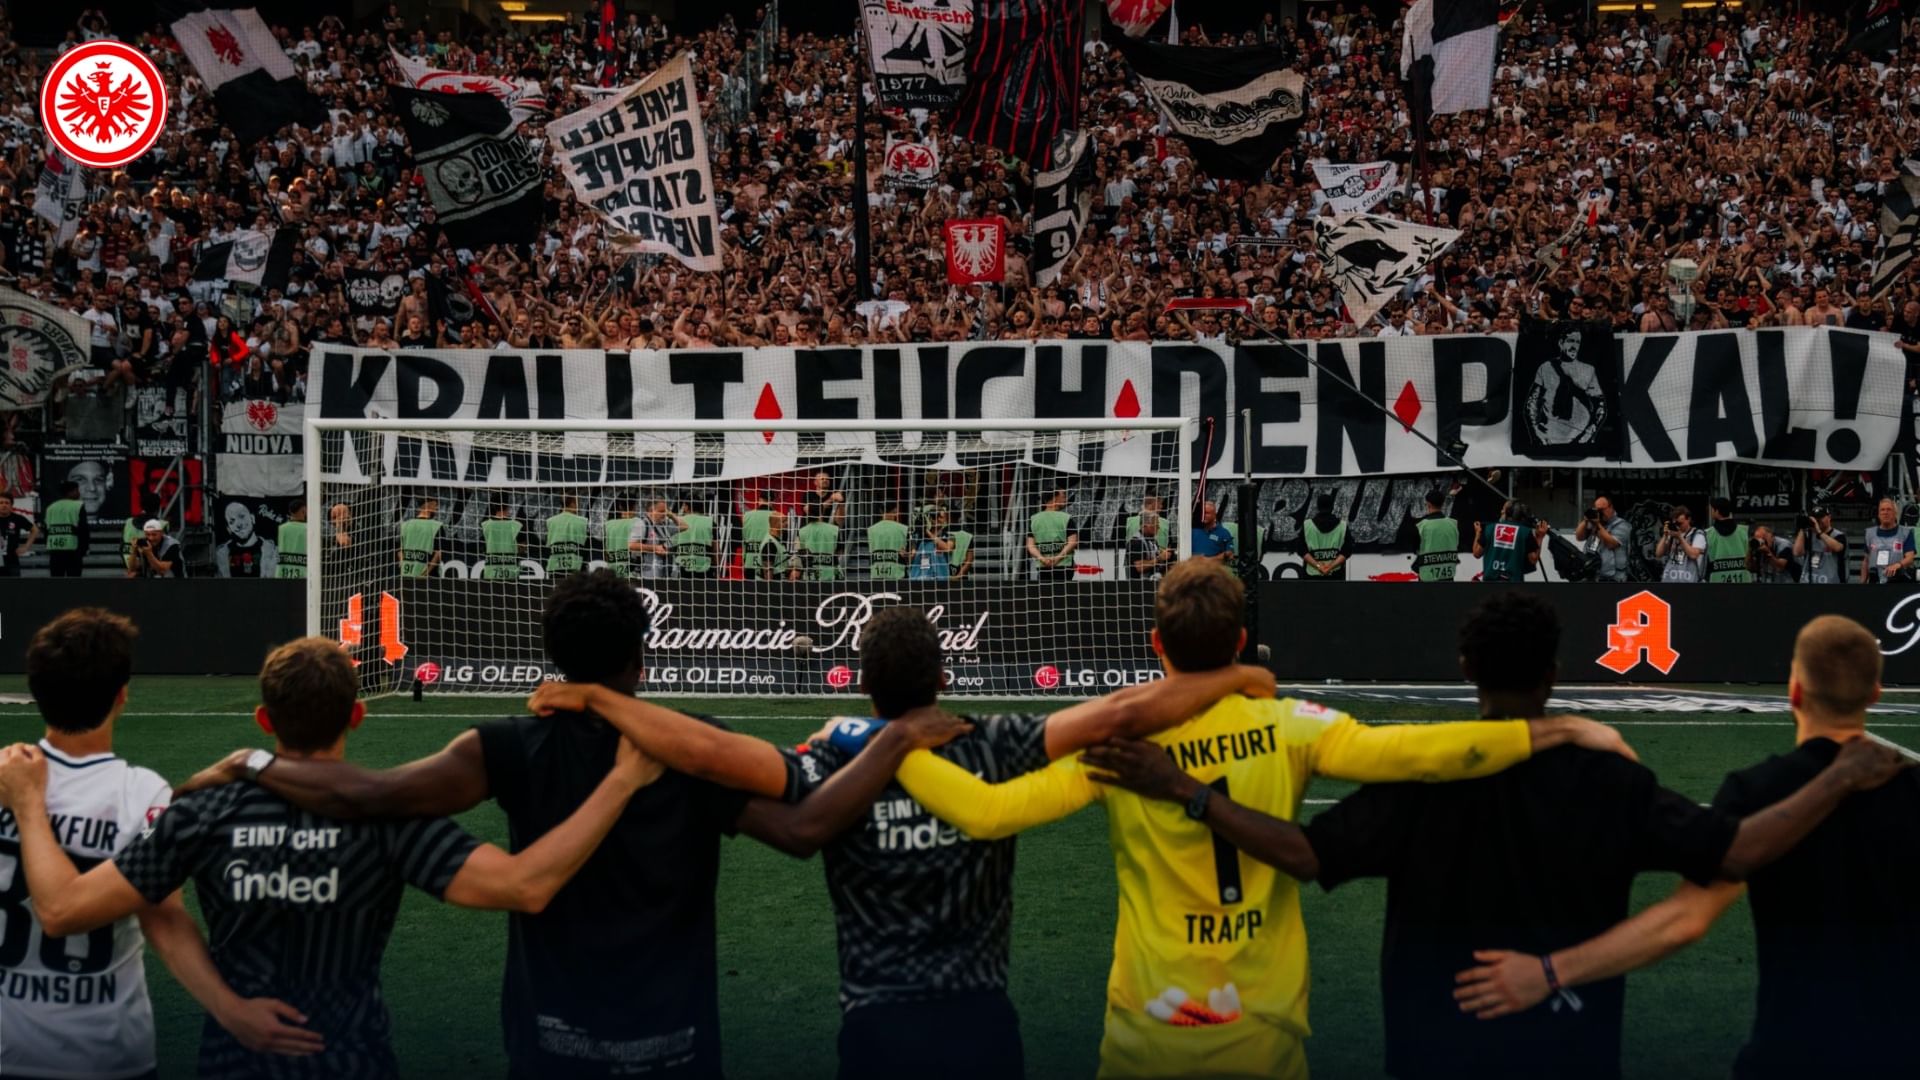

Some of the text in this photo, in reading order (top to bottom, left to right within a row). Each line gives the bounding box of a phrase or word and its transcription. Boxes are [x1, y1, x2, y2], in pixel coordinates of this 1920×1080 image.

[886, 0, 973, 24] Eintracht
[878, 77, 927, 91] 1977
[320, 352, 744, 482] KRALLT
[795, 345, 1108, 471] EUCH
[1150, 341, 1386, 475] DEN
[1433, 330, 1869, 466] PKAL!
[226, 434, 293, 454] NUOVA
[1424, 553, 1457, 565] STEWARD
[1663, 569, 1692, 580] FOTO
[443, 664, 473, 682] LG
[481, 664, 542, 683] OLED
[649, 667, 776, 684] LG OLED evo
[956, 675, 984, 686] evo
[1064, 671, 1095, 686] LG
[1184, 909, 1263, 944] TRAPP
